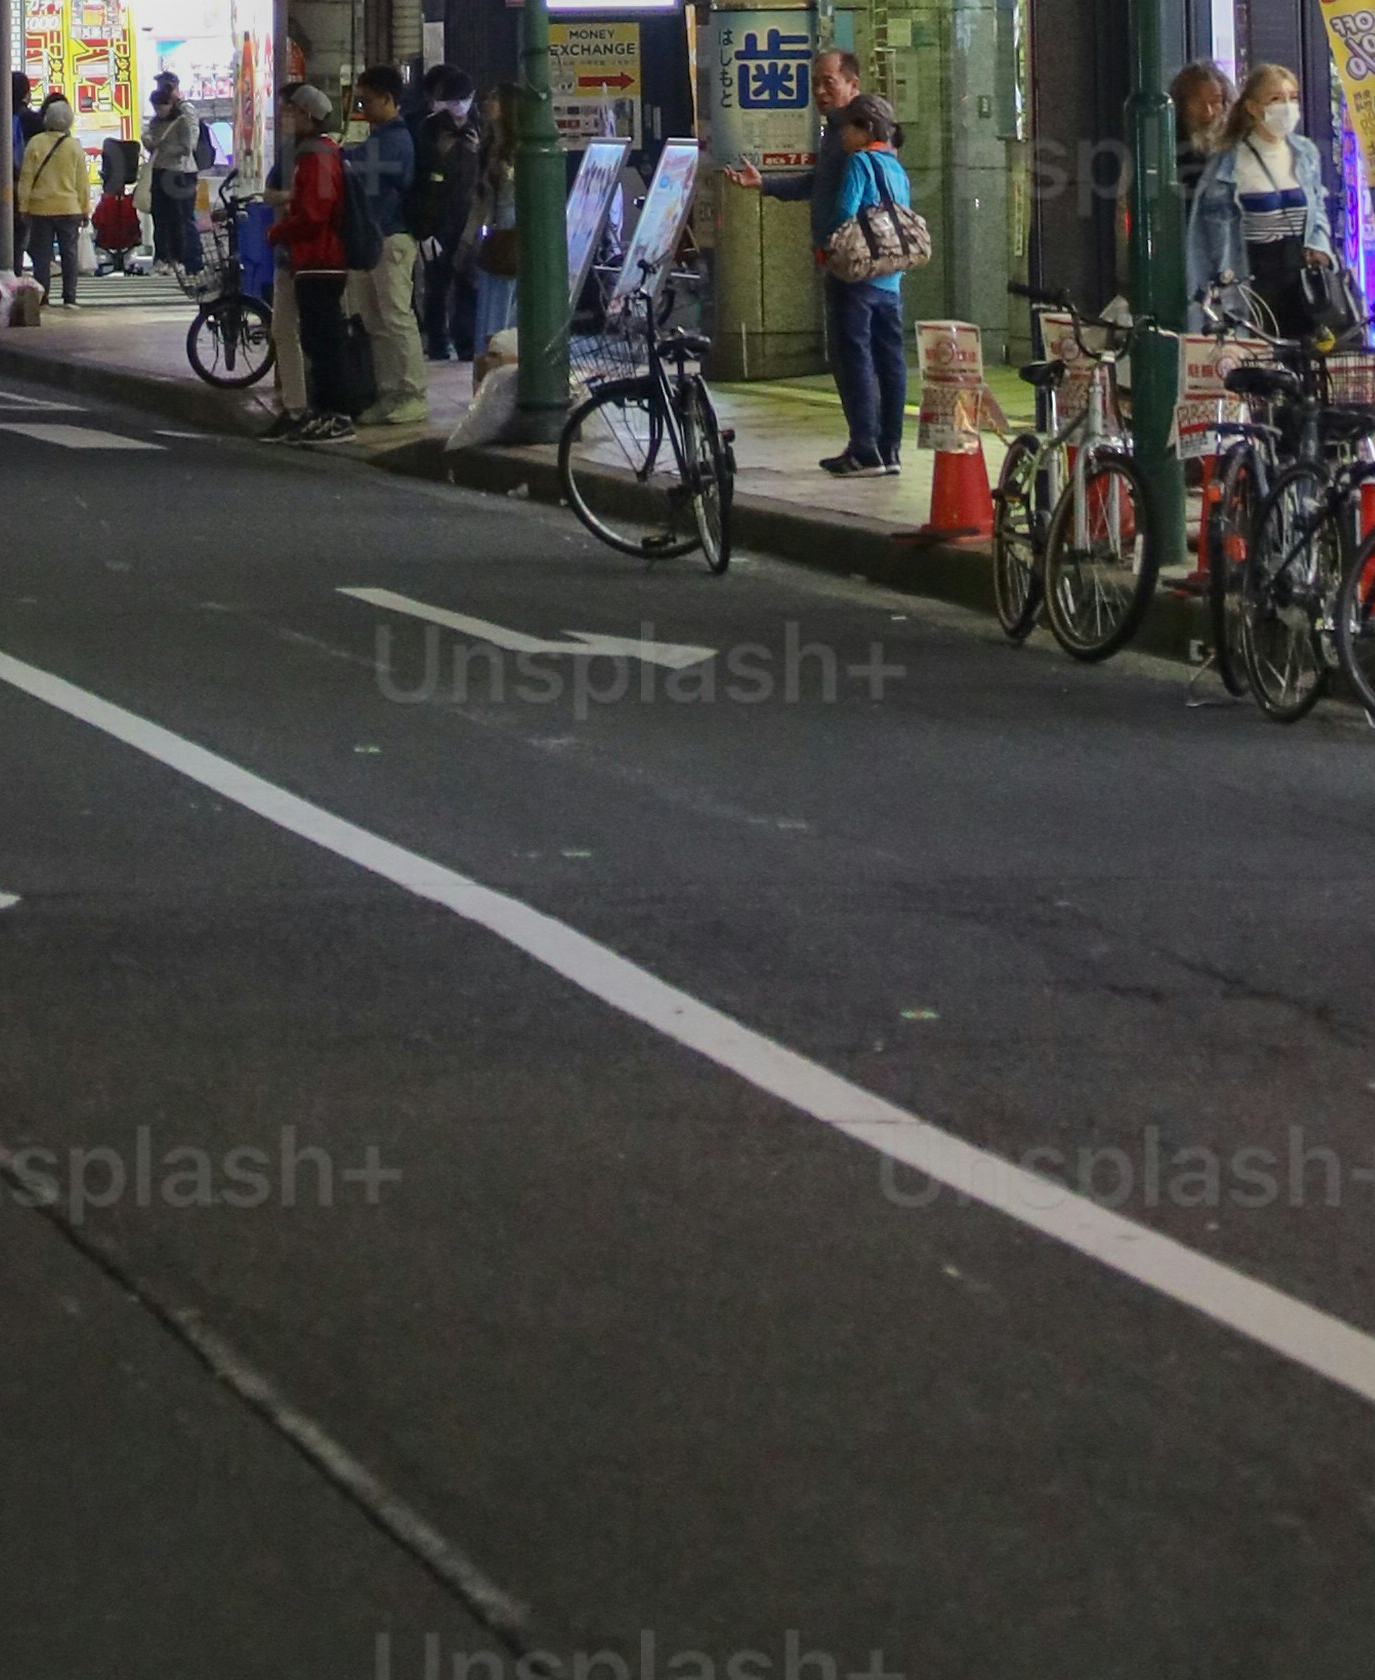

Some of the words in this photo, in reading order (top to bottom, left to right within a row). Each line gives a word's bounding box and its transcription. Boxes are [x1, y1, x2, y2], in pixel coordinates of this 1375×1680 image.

[548, 42, 636, 56] EXCHANGE
[568, 29, 615, 40] MONEY
[718, 28, 734, 109] はしもと
[734, 28, 813, 110] 歯
